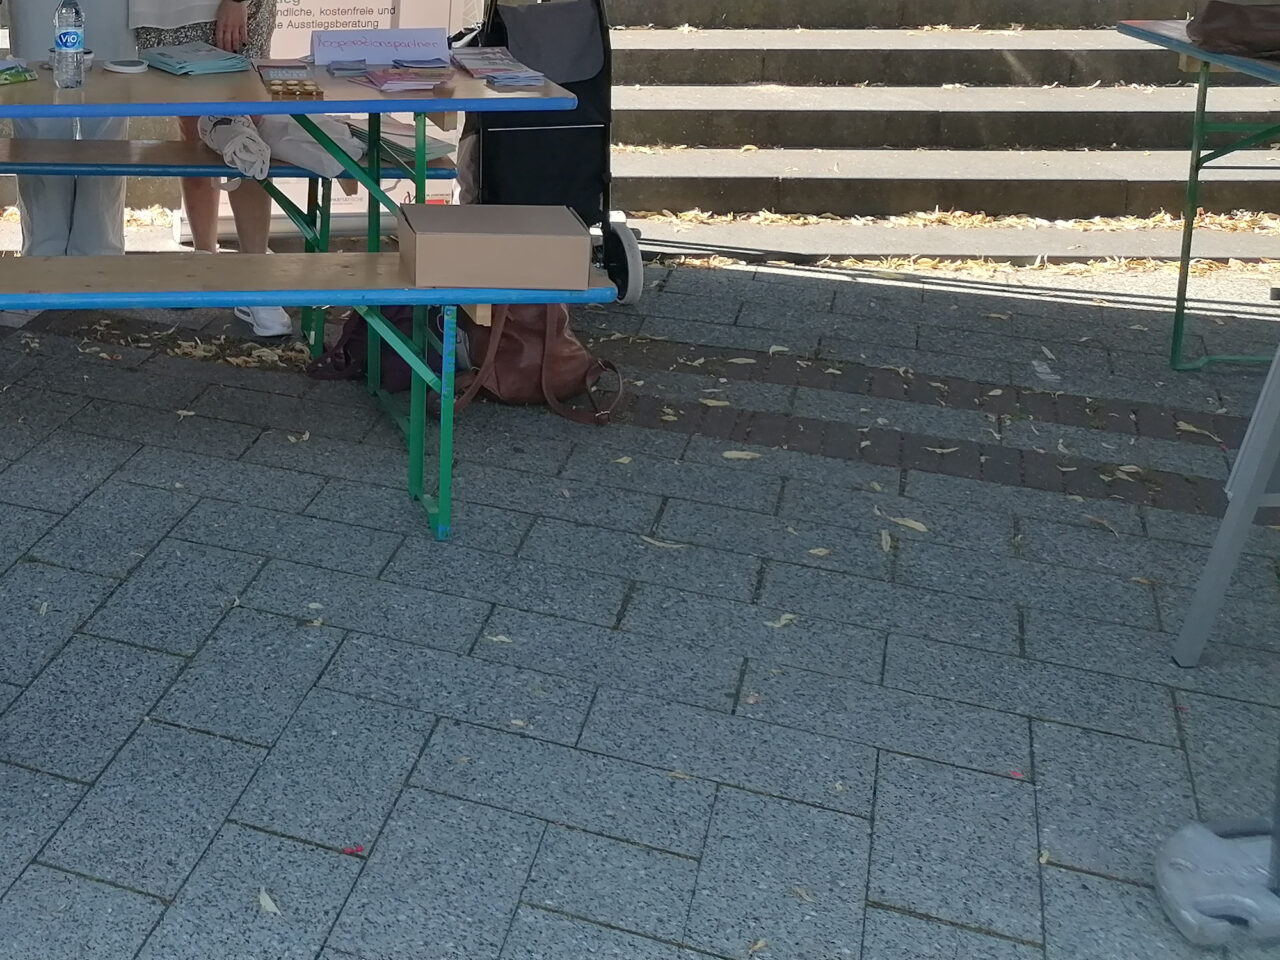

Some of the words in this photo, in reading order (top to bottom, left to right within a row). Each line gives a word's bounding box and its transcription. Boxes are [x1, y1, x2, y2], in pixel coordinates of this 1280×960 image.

[277, 7, 316, 18] ndliche,
[319, 6, 374, 16] kostenfreie
[377, 5, 396, 15] und
[287, 19, 379, 31] Ausstiegsberatung
